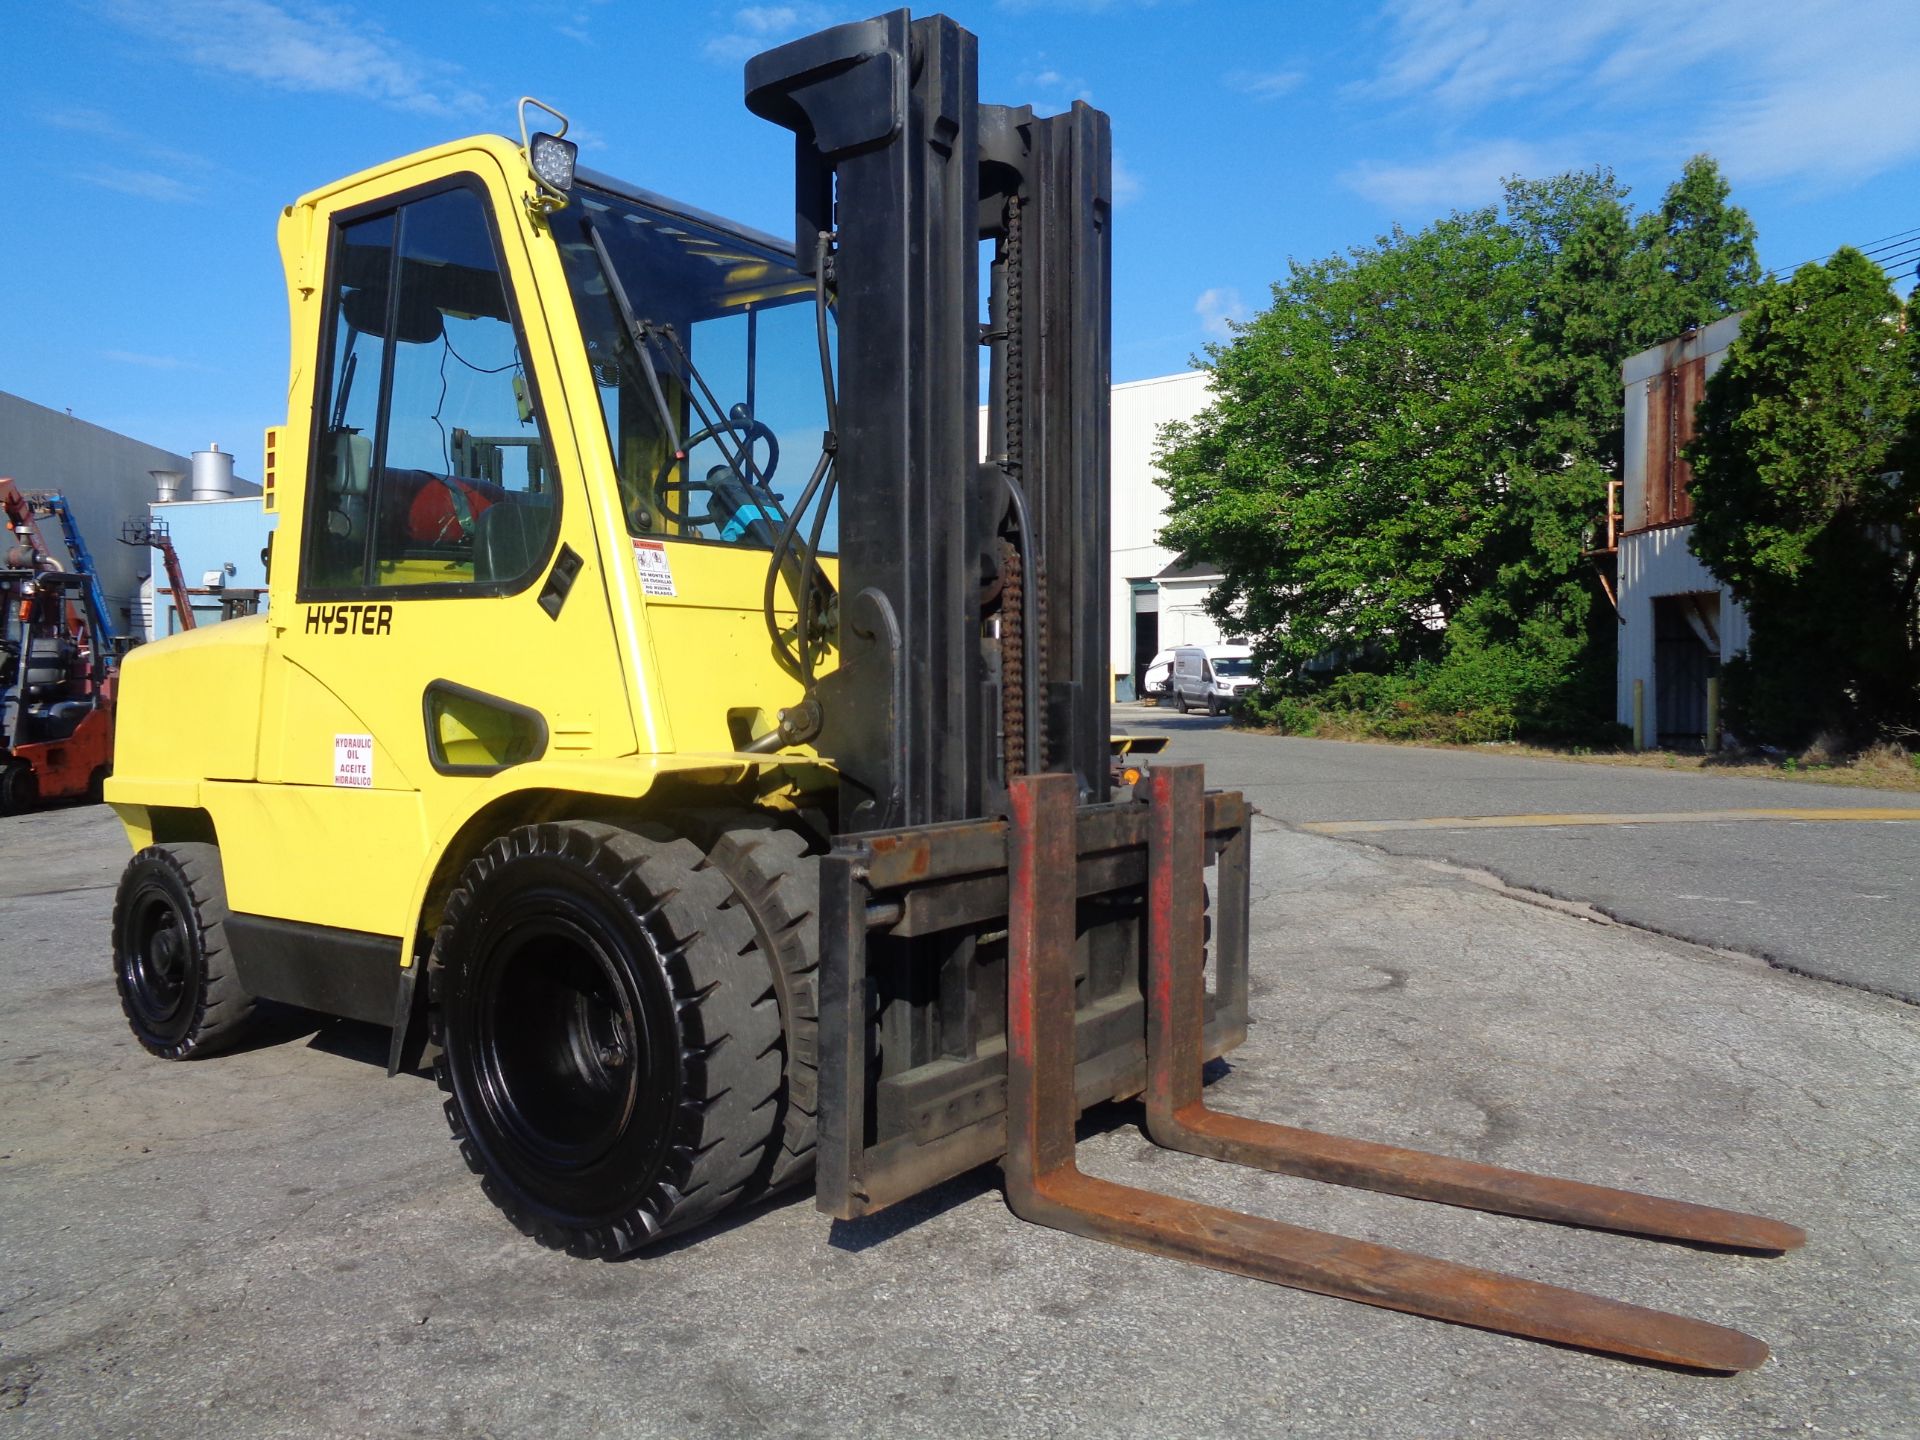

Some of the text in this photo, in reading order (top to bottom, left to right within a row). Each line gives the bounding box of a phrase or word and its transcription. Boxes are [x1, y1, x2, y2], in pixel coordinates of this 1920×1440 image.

[306, 605, 392, 635] HYSTER
[335, 738, 372, 749] HYDRAULIC
[347, 749, 359, 760] OIL
[340, 763, 366, 774] ACEITE
